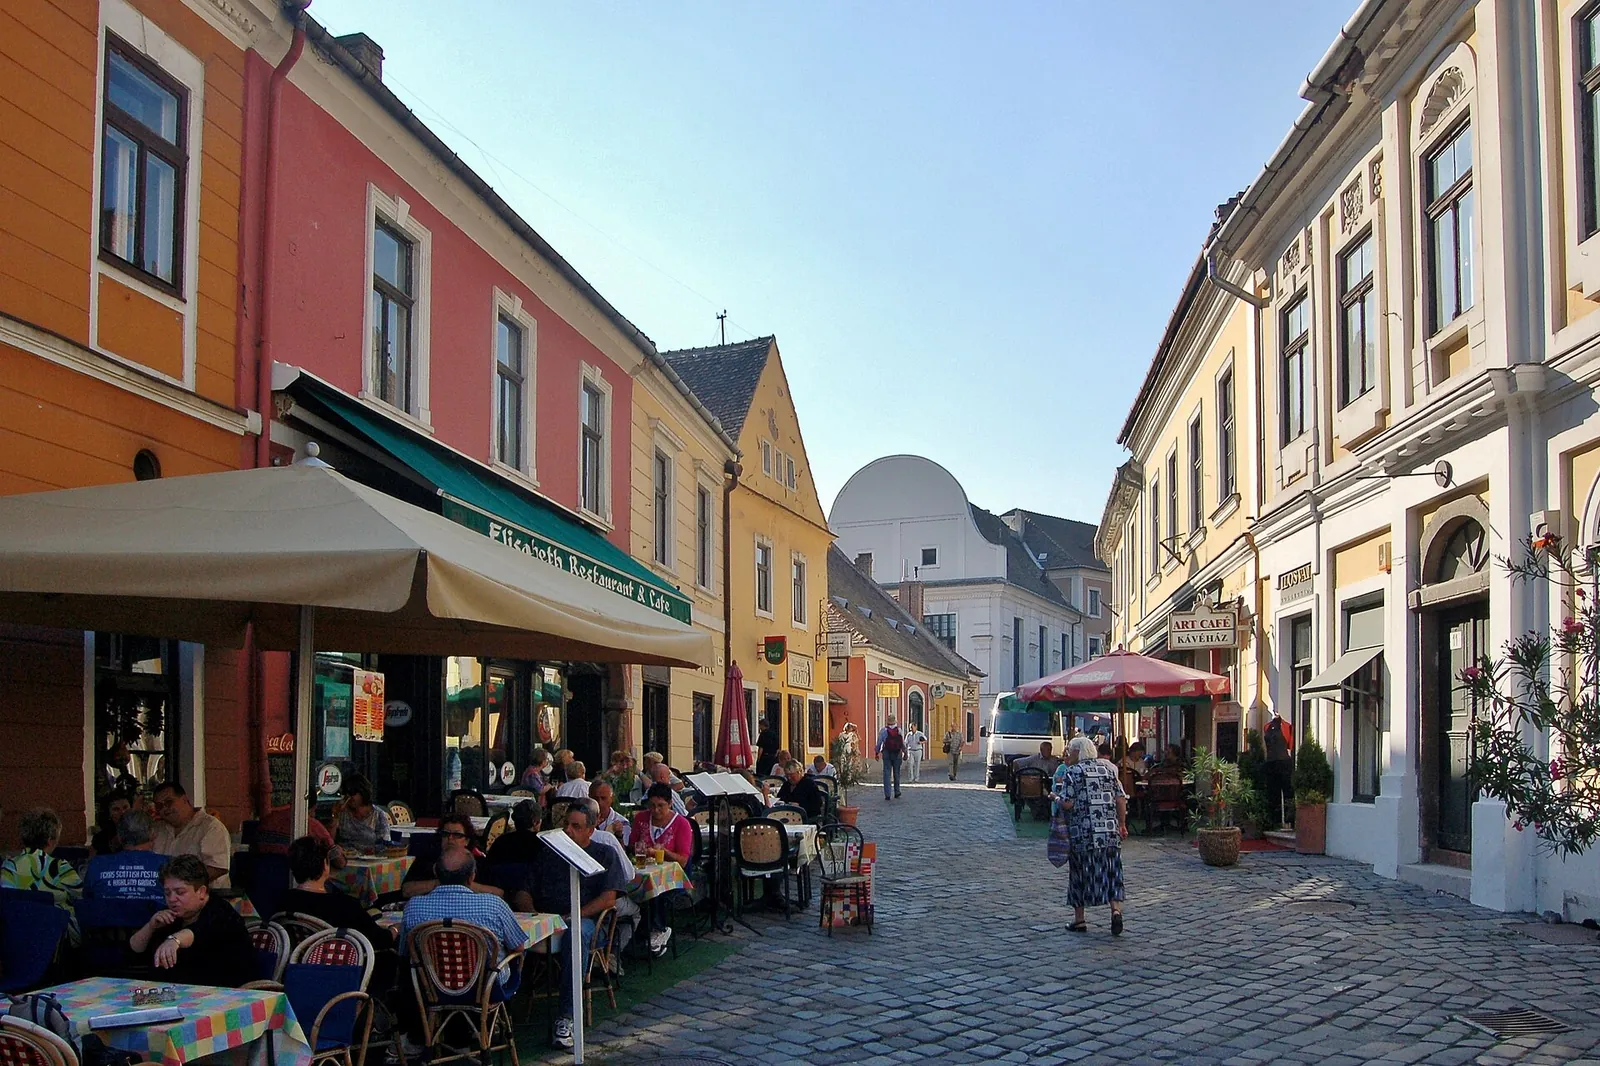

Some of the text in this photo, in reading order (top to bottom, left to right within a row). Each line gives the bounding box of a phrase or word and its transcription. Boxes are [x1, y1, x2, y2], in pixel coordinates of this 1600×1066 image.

[569, 554, 634, 600] Restaurant
[637, 585, 646, 603] &
[1173, 615, 1231, 630] ART CAFÉ
[1177, 631, 1228, 644] KÁVÉHÁZ
[116, 870, 139, 878] SCOTTISH
